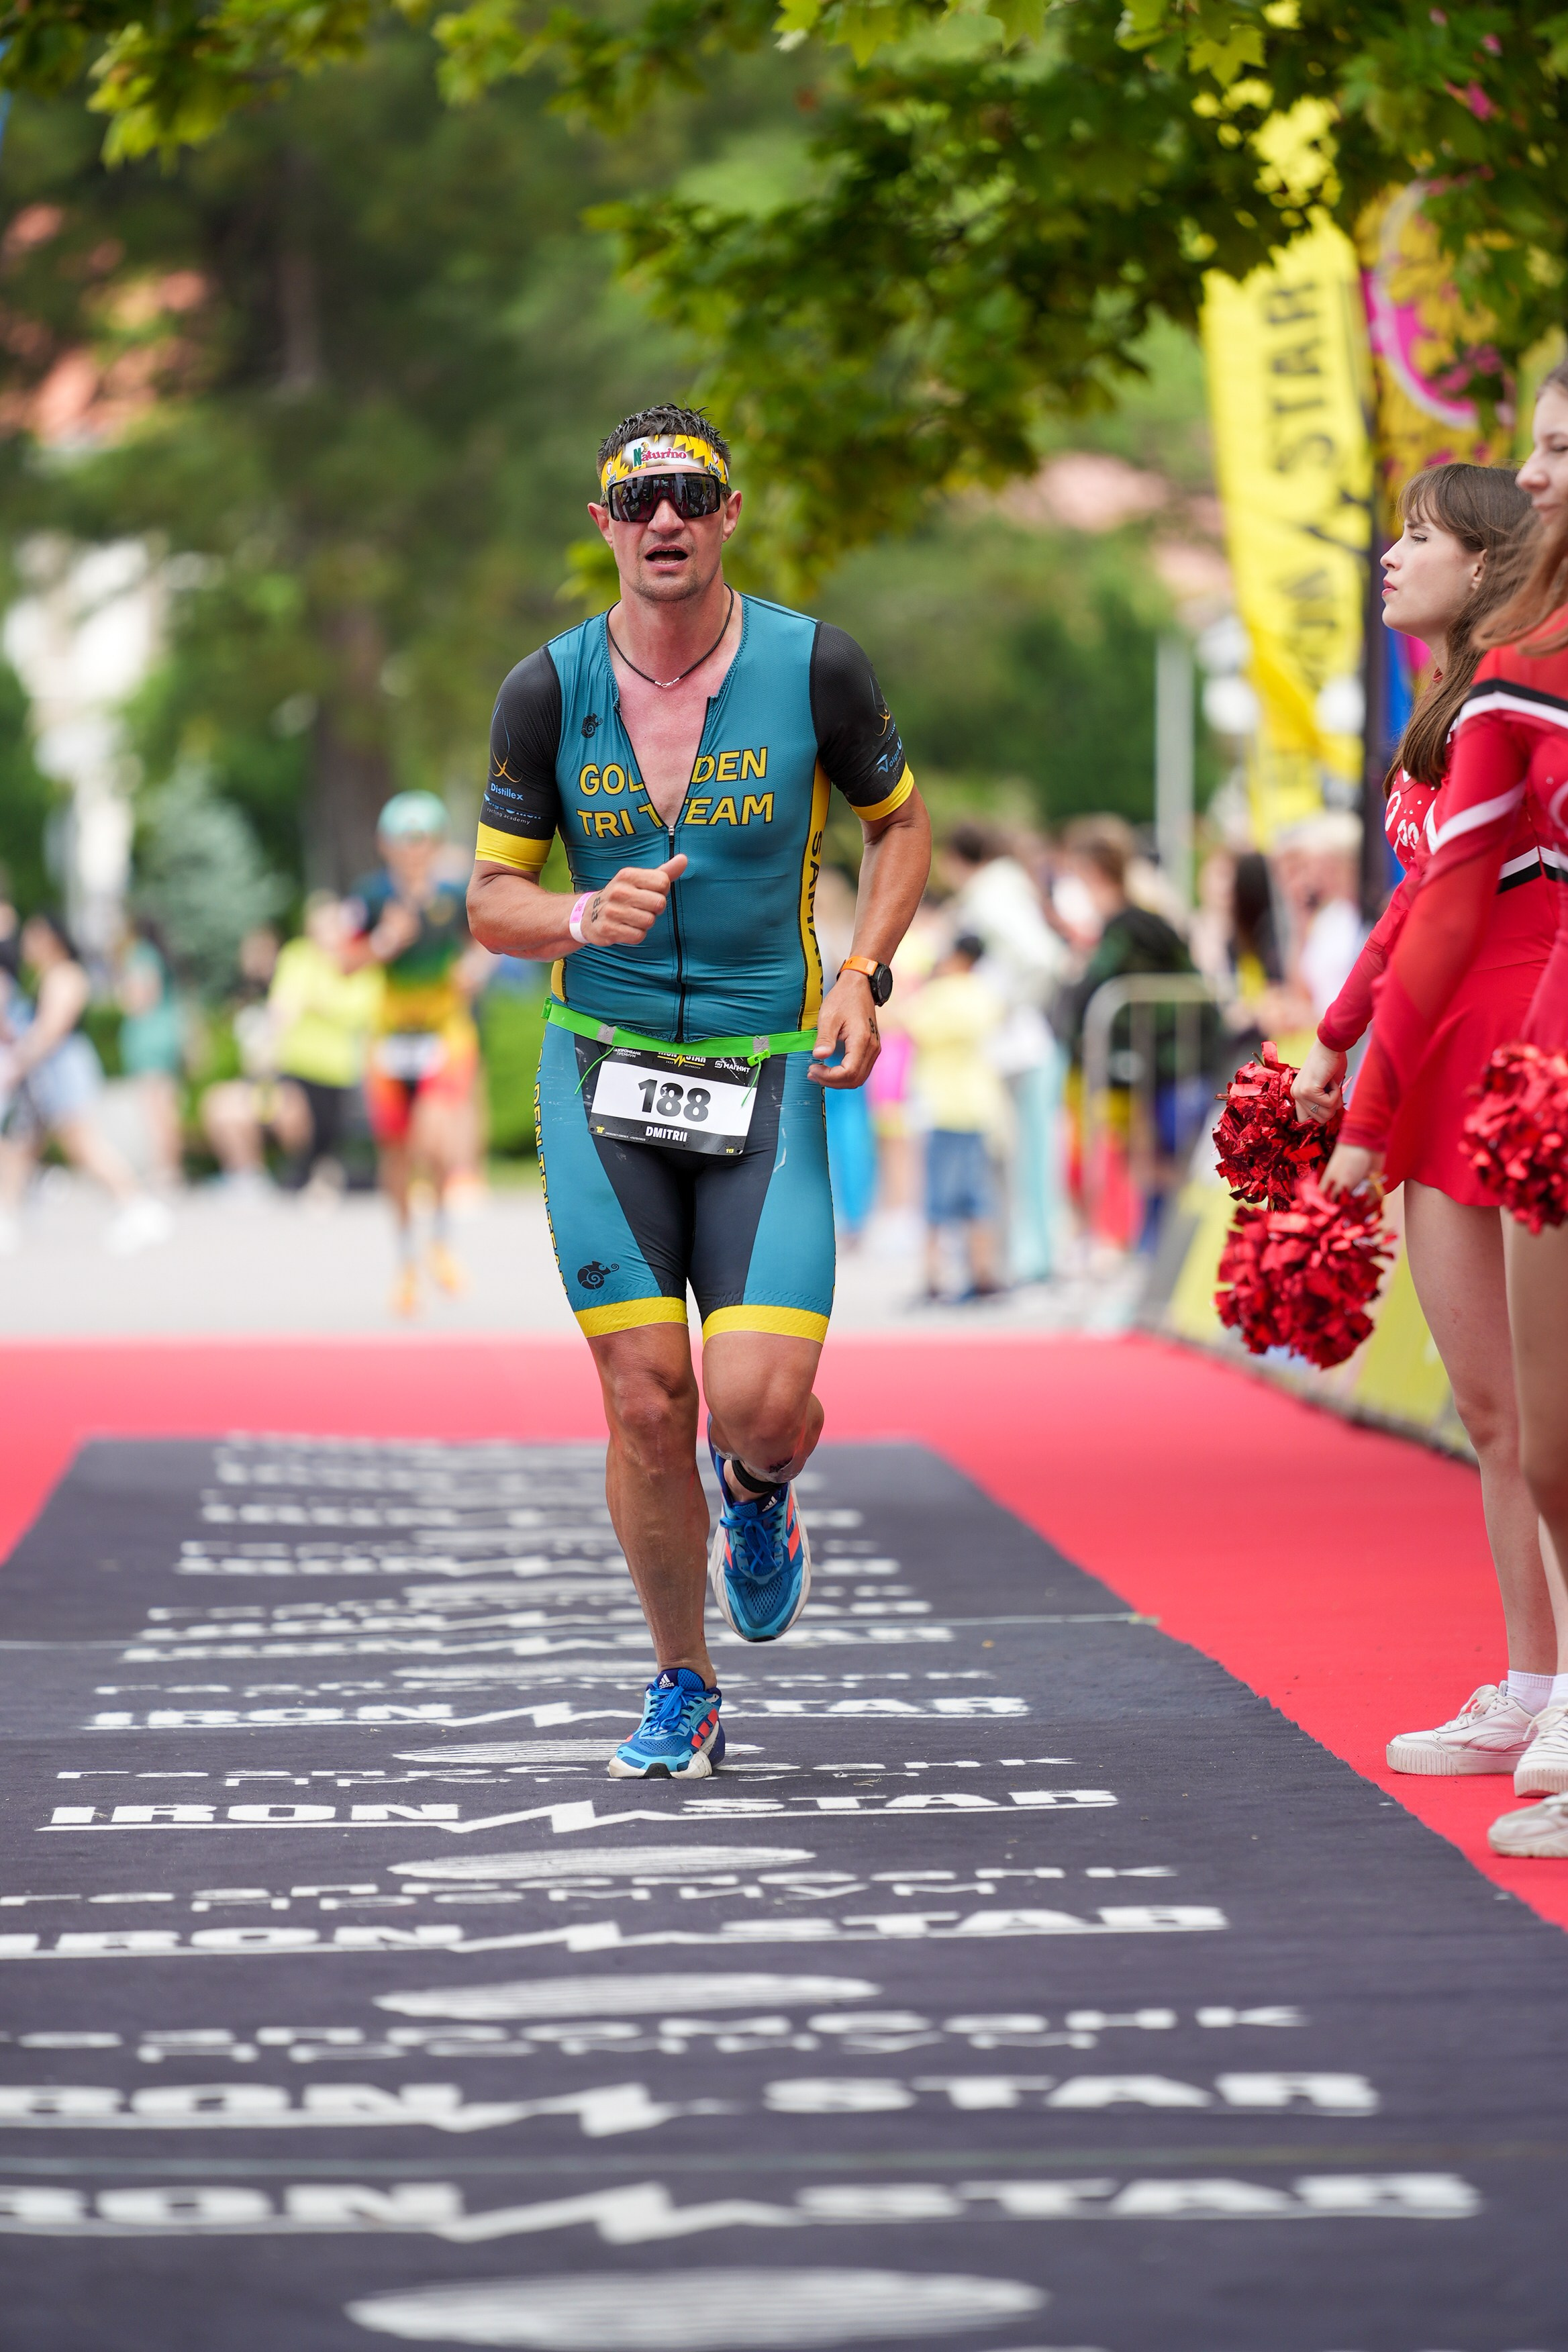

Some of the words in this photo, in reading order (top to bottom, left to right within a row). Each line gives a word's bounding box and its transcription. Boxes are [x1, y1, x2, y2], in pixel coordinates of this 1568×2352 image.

[1261, 277, 1336, 474] STAR
[633, 447, 687, 467] Naturino
[579, 746, 768, 797] GOLDEN
[490, 783, 524, 801] Distillex
[487, 807, 503, 818] cycling
[503, 814, 530, 826] academy
[577, 808, 636, 838] TRI
[638, 792, 775, 828] TEAM
[724, 1064, 750, 1073] МАГНИТ
[638, 1079, 711, 1122] 188
[645, 1126, 687, 1142] DMITRII
[91, 1704, 454, 1726] IRON
[50, 1804, 460, 1824] IRON
[682, 1790, 1118, 1812] STAR
[0, 1924, 463, 1951] IRON
[721, 1906, 1228, 1935] STAR
[763, 2073, 1379, 2114] STAR
[795, 2172, 1481, 2218] STAR
